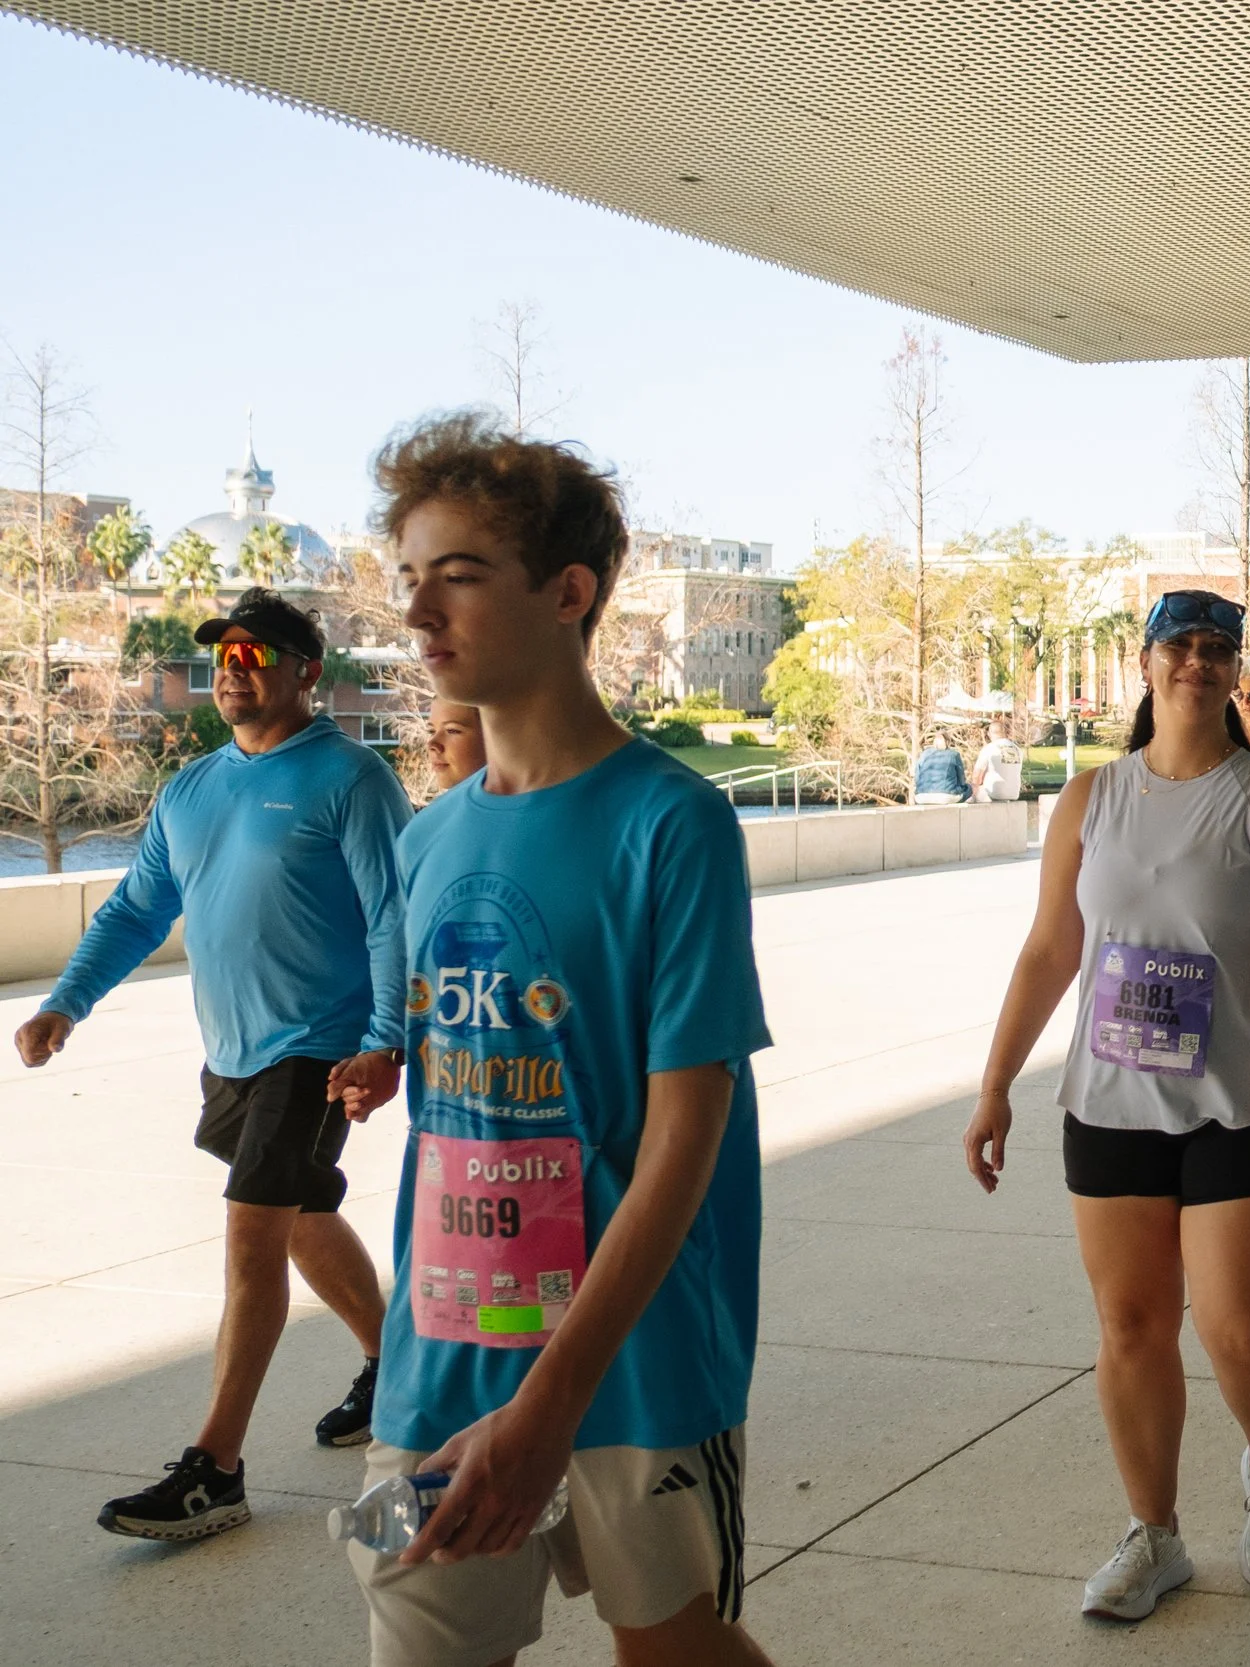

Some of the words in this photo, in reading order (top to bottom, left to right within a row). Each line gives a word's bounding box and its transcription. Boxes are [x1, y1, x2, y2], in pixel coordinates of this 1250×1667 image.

[1144, 959, 1205, 980] Publix
[436, 966, 512, 1030] 5K
[1119, 980, 1175, 1011] 6981
[1113, 1005, 1181, 1026] BRENDA
[513, 1106, 568, 1119] CLASSIC
[466, 1155, 564, 1183] Publix
[440, 1193, 521, 1239] 9669
